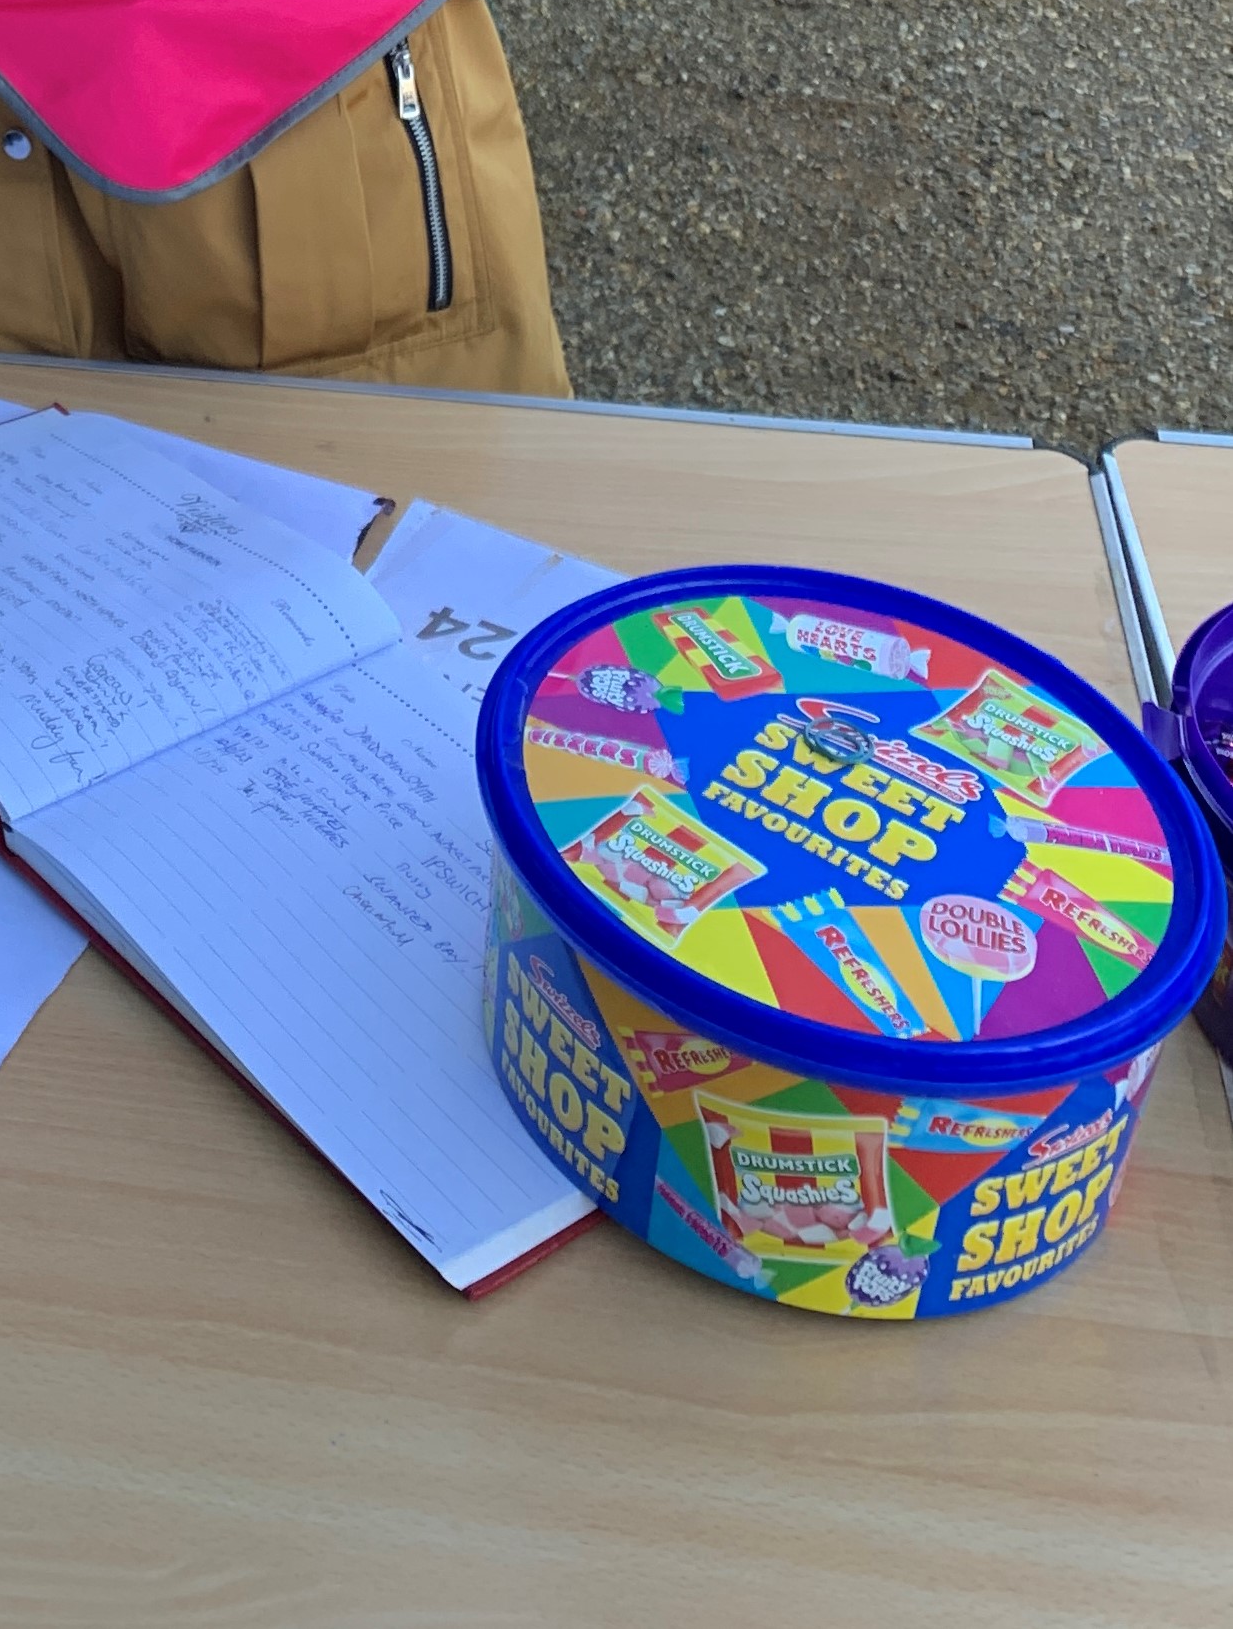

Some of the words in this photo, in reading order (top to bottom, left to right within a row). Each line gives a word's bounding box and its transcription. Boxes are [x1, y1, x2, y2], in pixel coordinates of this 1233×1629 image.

[415, 606, 519, 661] 24
[677, 614, 750, 675] DRUMSTICK
[796, 628, 878, 663] HEARTS
[984, 702, 1072, 750] DRUMSTICK
[720, 748, 938, 868] SHOP
[754, 723, 966, 833] SWEET
[630, 820, 716, 880] DRUMSTICK
[702, 780, 910, 901] FAVOURITES
[421, 852, 490, 914] IPSWICH
[930, 901, 1026, 937] DOUBLE
[928, 914, 1028, 956] LOLLIES
[1039, 885, 1156, 965] REFRESHERS
[816, 923, 911, 1033] REFRESHERS
[506, 951, 632, 1115] SWEET
[653, 1044, 734, 1074] REFRESHE
[504, 998, 627, 1162] SHOP
[501, 1047, 621, 1204] FAVOURITES
[737, 1152, 852, 1173] DRUMSTICK
[970, 1113, 1129, 1217] SWEET
[956, 1162, 1114, 1273] SHOP
[948, 1214, 1100, 1302] FAVOURITES
